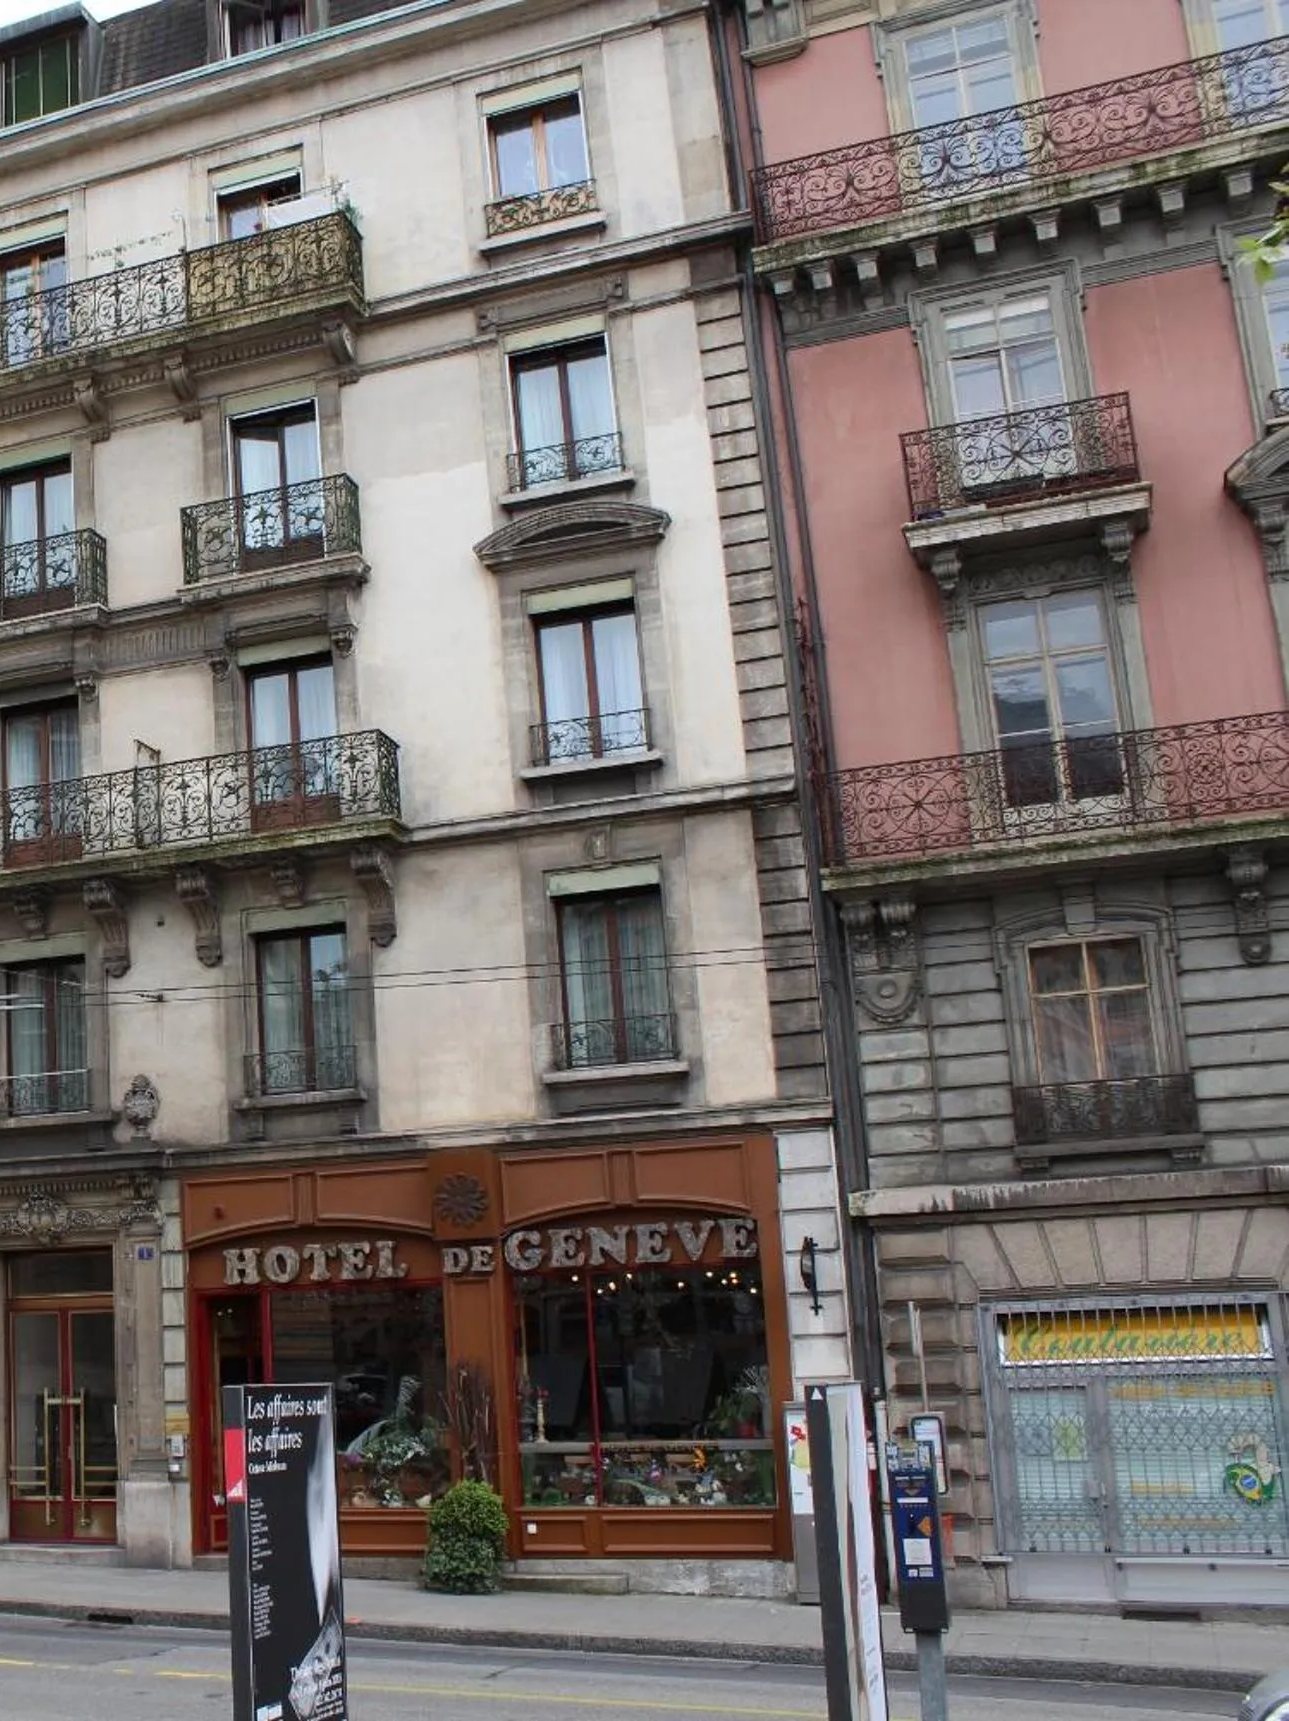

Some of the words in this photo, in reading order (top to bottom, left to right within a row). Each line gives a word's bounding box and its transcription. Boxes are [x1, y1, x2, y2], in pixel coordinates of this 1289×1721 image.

[223, 1240, 408, 1286] HOTEL
[441, 1246, 496, 1275] DE
[505, 1218, 759, 1271] GENEVE
[247, 1395, 265, 1420] Les
[267, 1393, 305, 1426] affaires
[306, 1394, 327, 1416] sont
[248, 1428, 263, 1455] les
[264, 1426, 303, 1459] affaires
